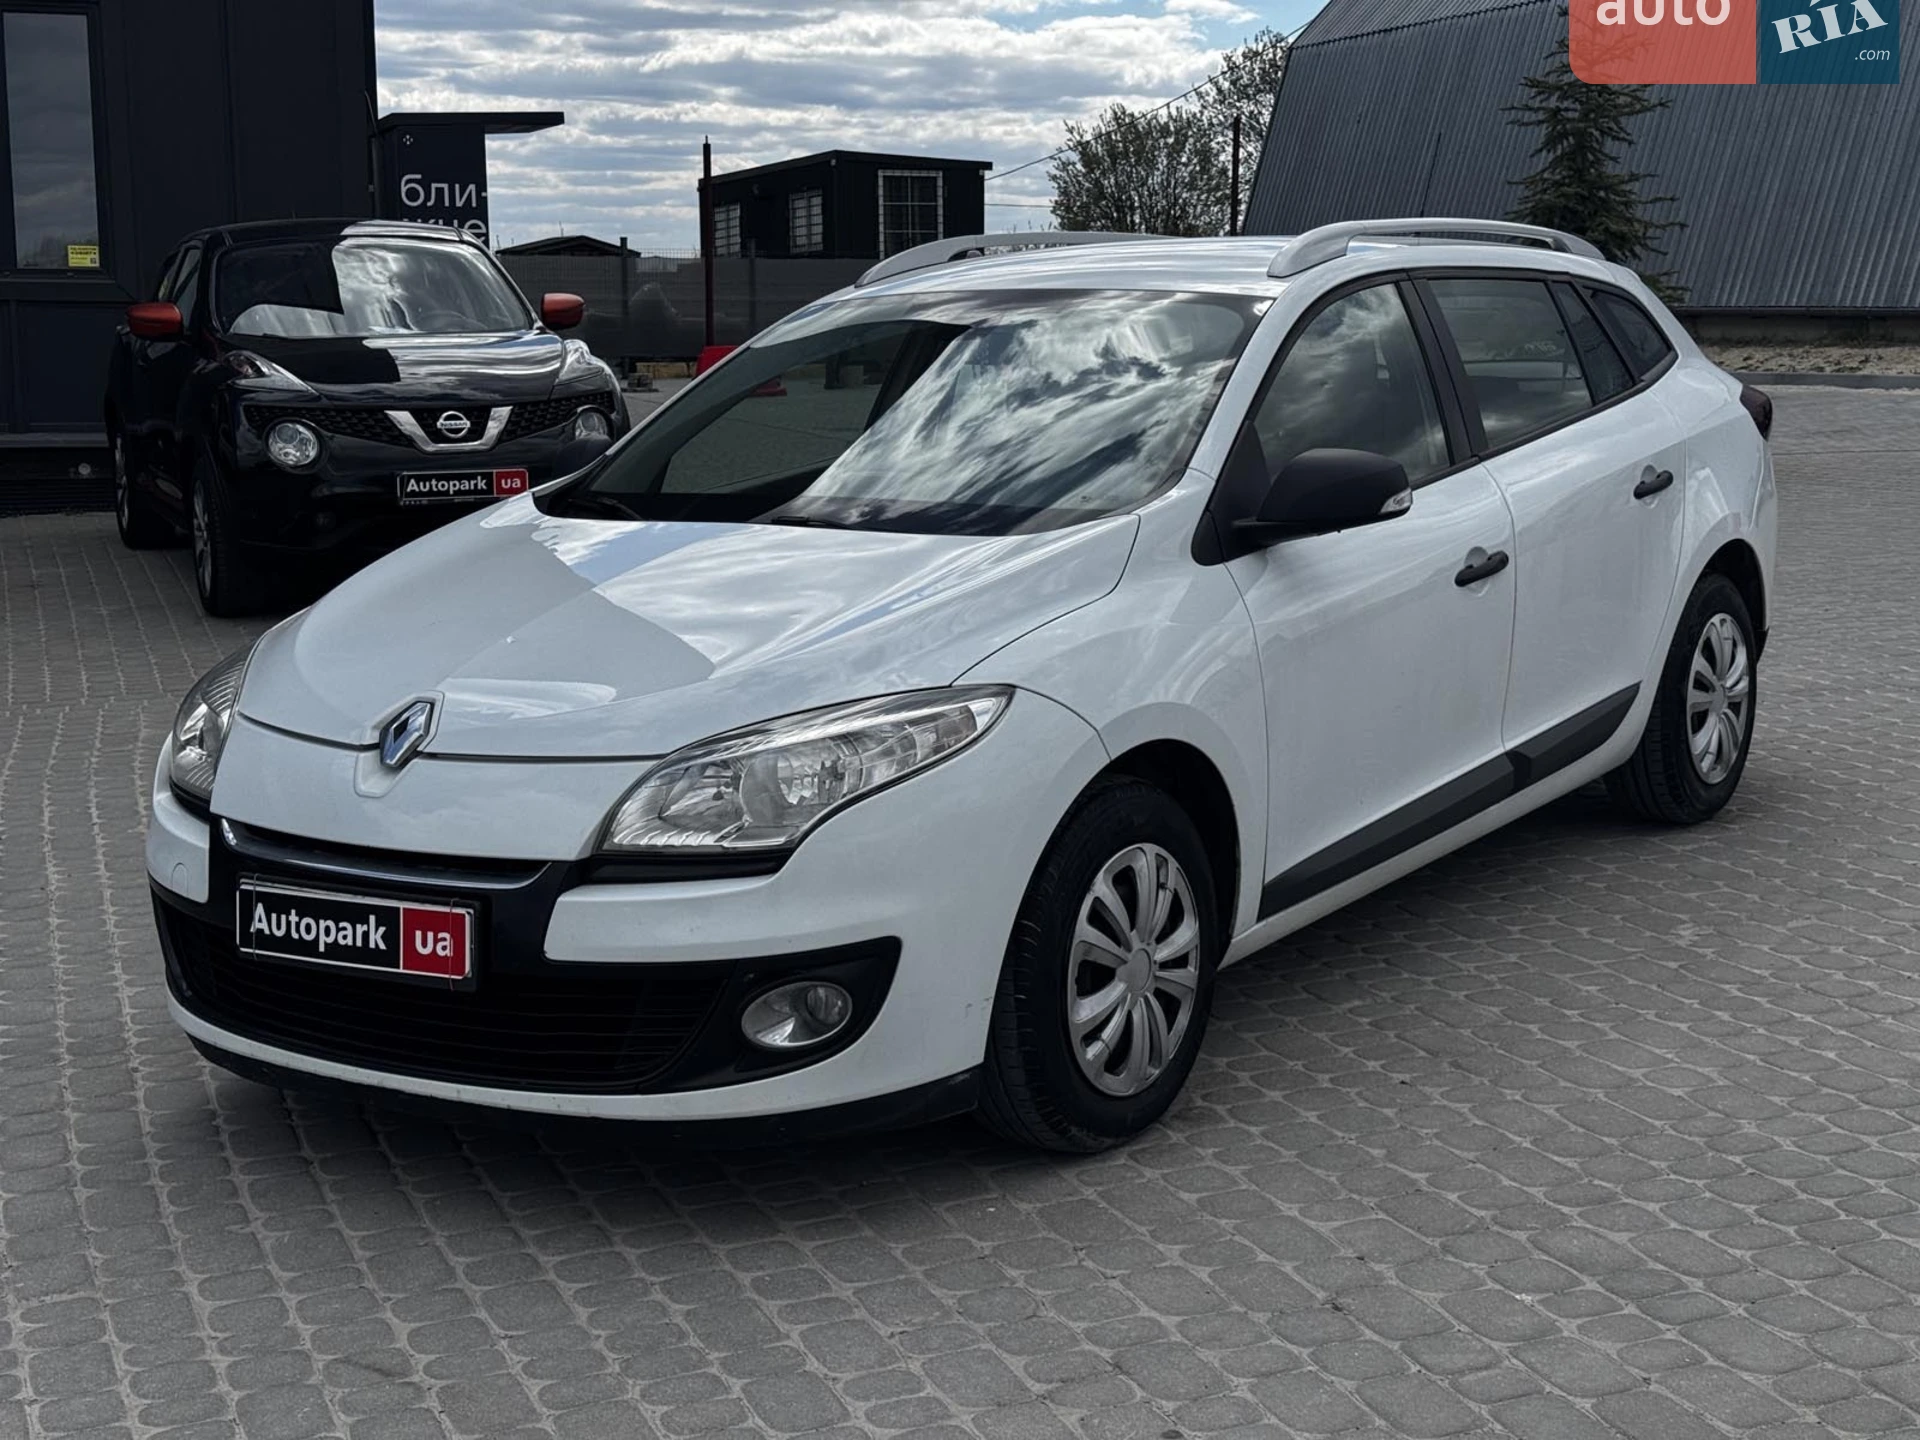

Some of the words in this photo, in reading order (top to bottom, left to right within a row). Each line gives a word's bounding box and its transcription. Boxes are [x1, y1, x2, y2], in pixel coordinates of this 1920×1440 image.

[406, 475, 488, 495] Autopark
[501, 479, 521, 489] ua
[250, 902, 387, 952] Autopark
[414, 930, 454, 957] ua
